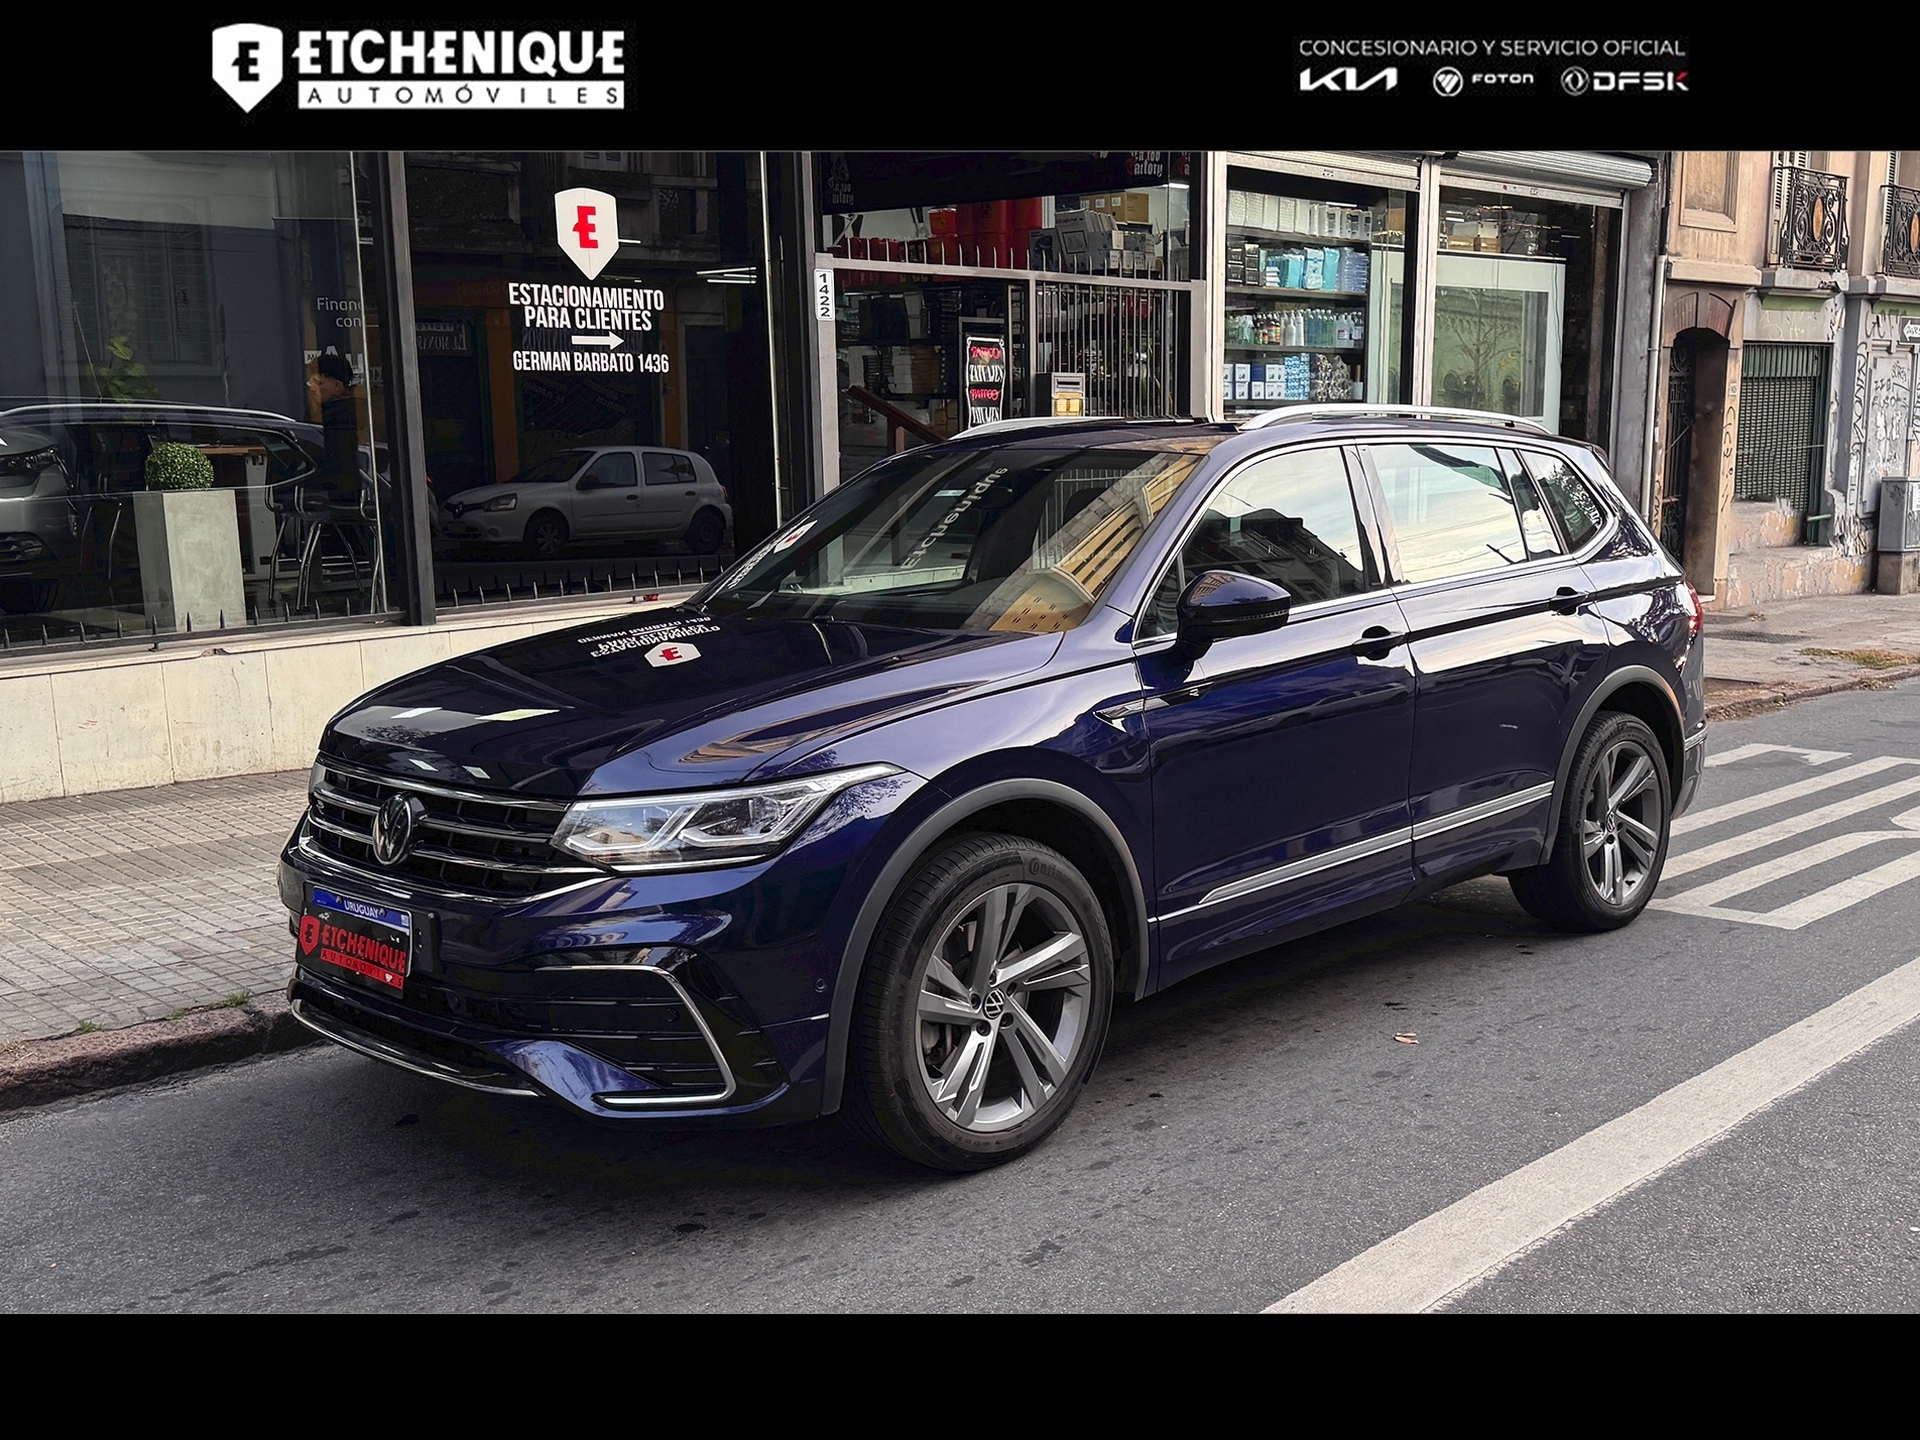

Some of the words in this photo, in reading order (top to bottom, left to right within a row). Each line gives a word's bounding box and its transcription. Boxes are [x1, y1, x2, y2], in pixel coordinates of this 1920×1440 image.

[508, 282, 665, 311] ESTACIONAMIENTO
[818, 272, 830, 317] 1422
[524, 305, 572, 329] PARA
[574, 308, 652, 332] CLIENTES
[512, 350, 571, 372] GERMAN
[574, 351, 634, 373] BARBATO
[638, 353, 670, 373] 1436
[343, 900, 380, 919] URUGUAY
[321, 924, 406, 974] ETCHENIQUE
